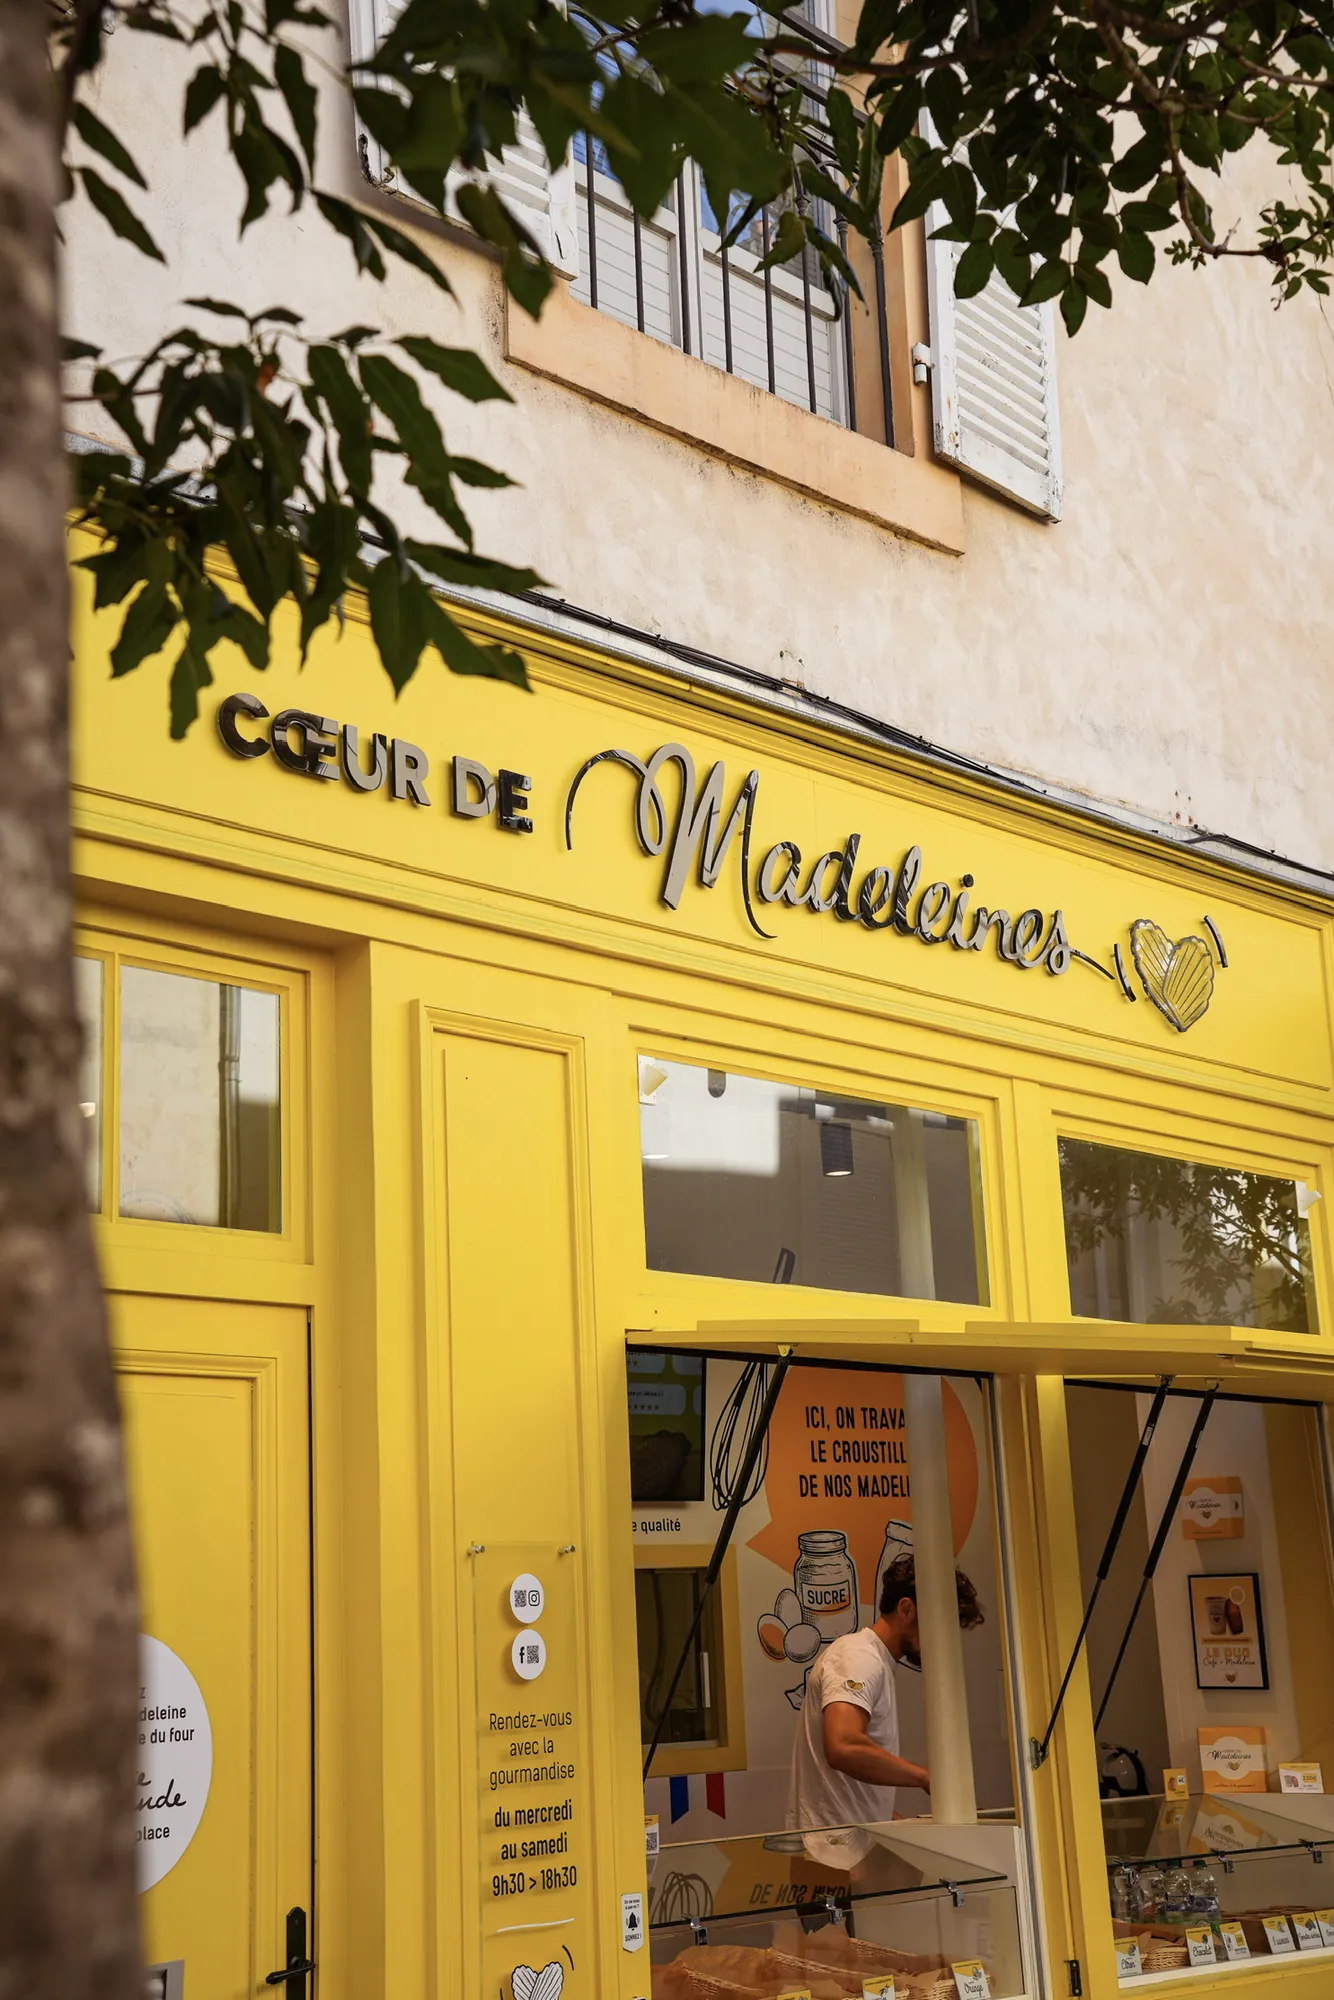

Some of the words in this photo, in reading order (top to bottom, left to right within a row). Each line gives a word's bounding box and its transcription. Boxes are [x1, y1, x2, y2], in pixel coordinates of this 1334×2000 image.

[217, 692, 432, 806] CŒUR
[452, 755, 533, 834] DE
[566, 743, 1114, 978] Madeleines
[805, 1406, 830, 1432] ICI,
[836, 1406, 855, 1429] ON
[811, 1440, 827, 1463] LE
[799, 1474, 818, 1497] DE
[824, 1474, 852, 1498] NOS
[641, 1518, 681, 1535] qualité
[807, 1588, 847, 1605] SUCRE
[489, 1711, 573, 1731] Rendez-vous
[150, 1729, 166, 1744] du
[169, 1727, 195, 1743] four
[510, 1741, 539, 1756] avec
[543, 1736, 554, 1754] la
[489, 1761, 575, 1791] gourmandise
[494, 1806, 510, 1828] du
[515, 1798, 572, 1826] mercredi
[501, 1843, 517, 1860] au
[521, 1831, 568, 1858] samedi
[492, 1872, 525, 1896] 9h30
[540, 1865, 577, 1890] 18h30
